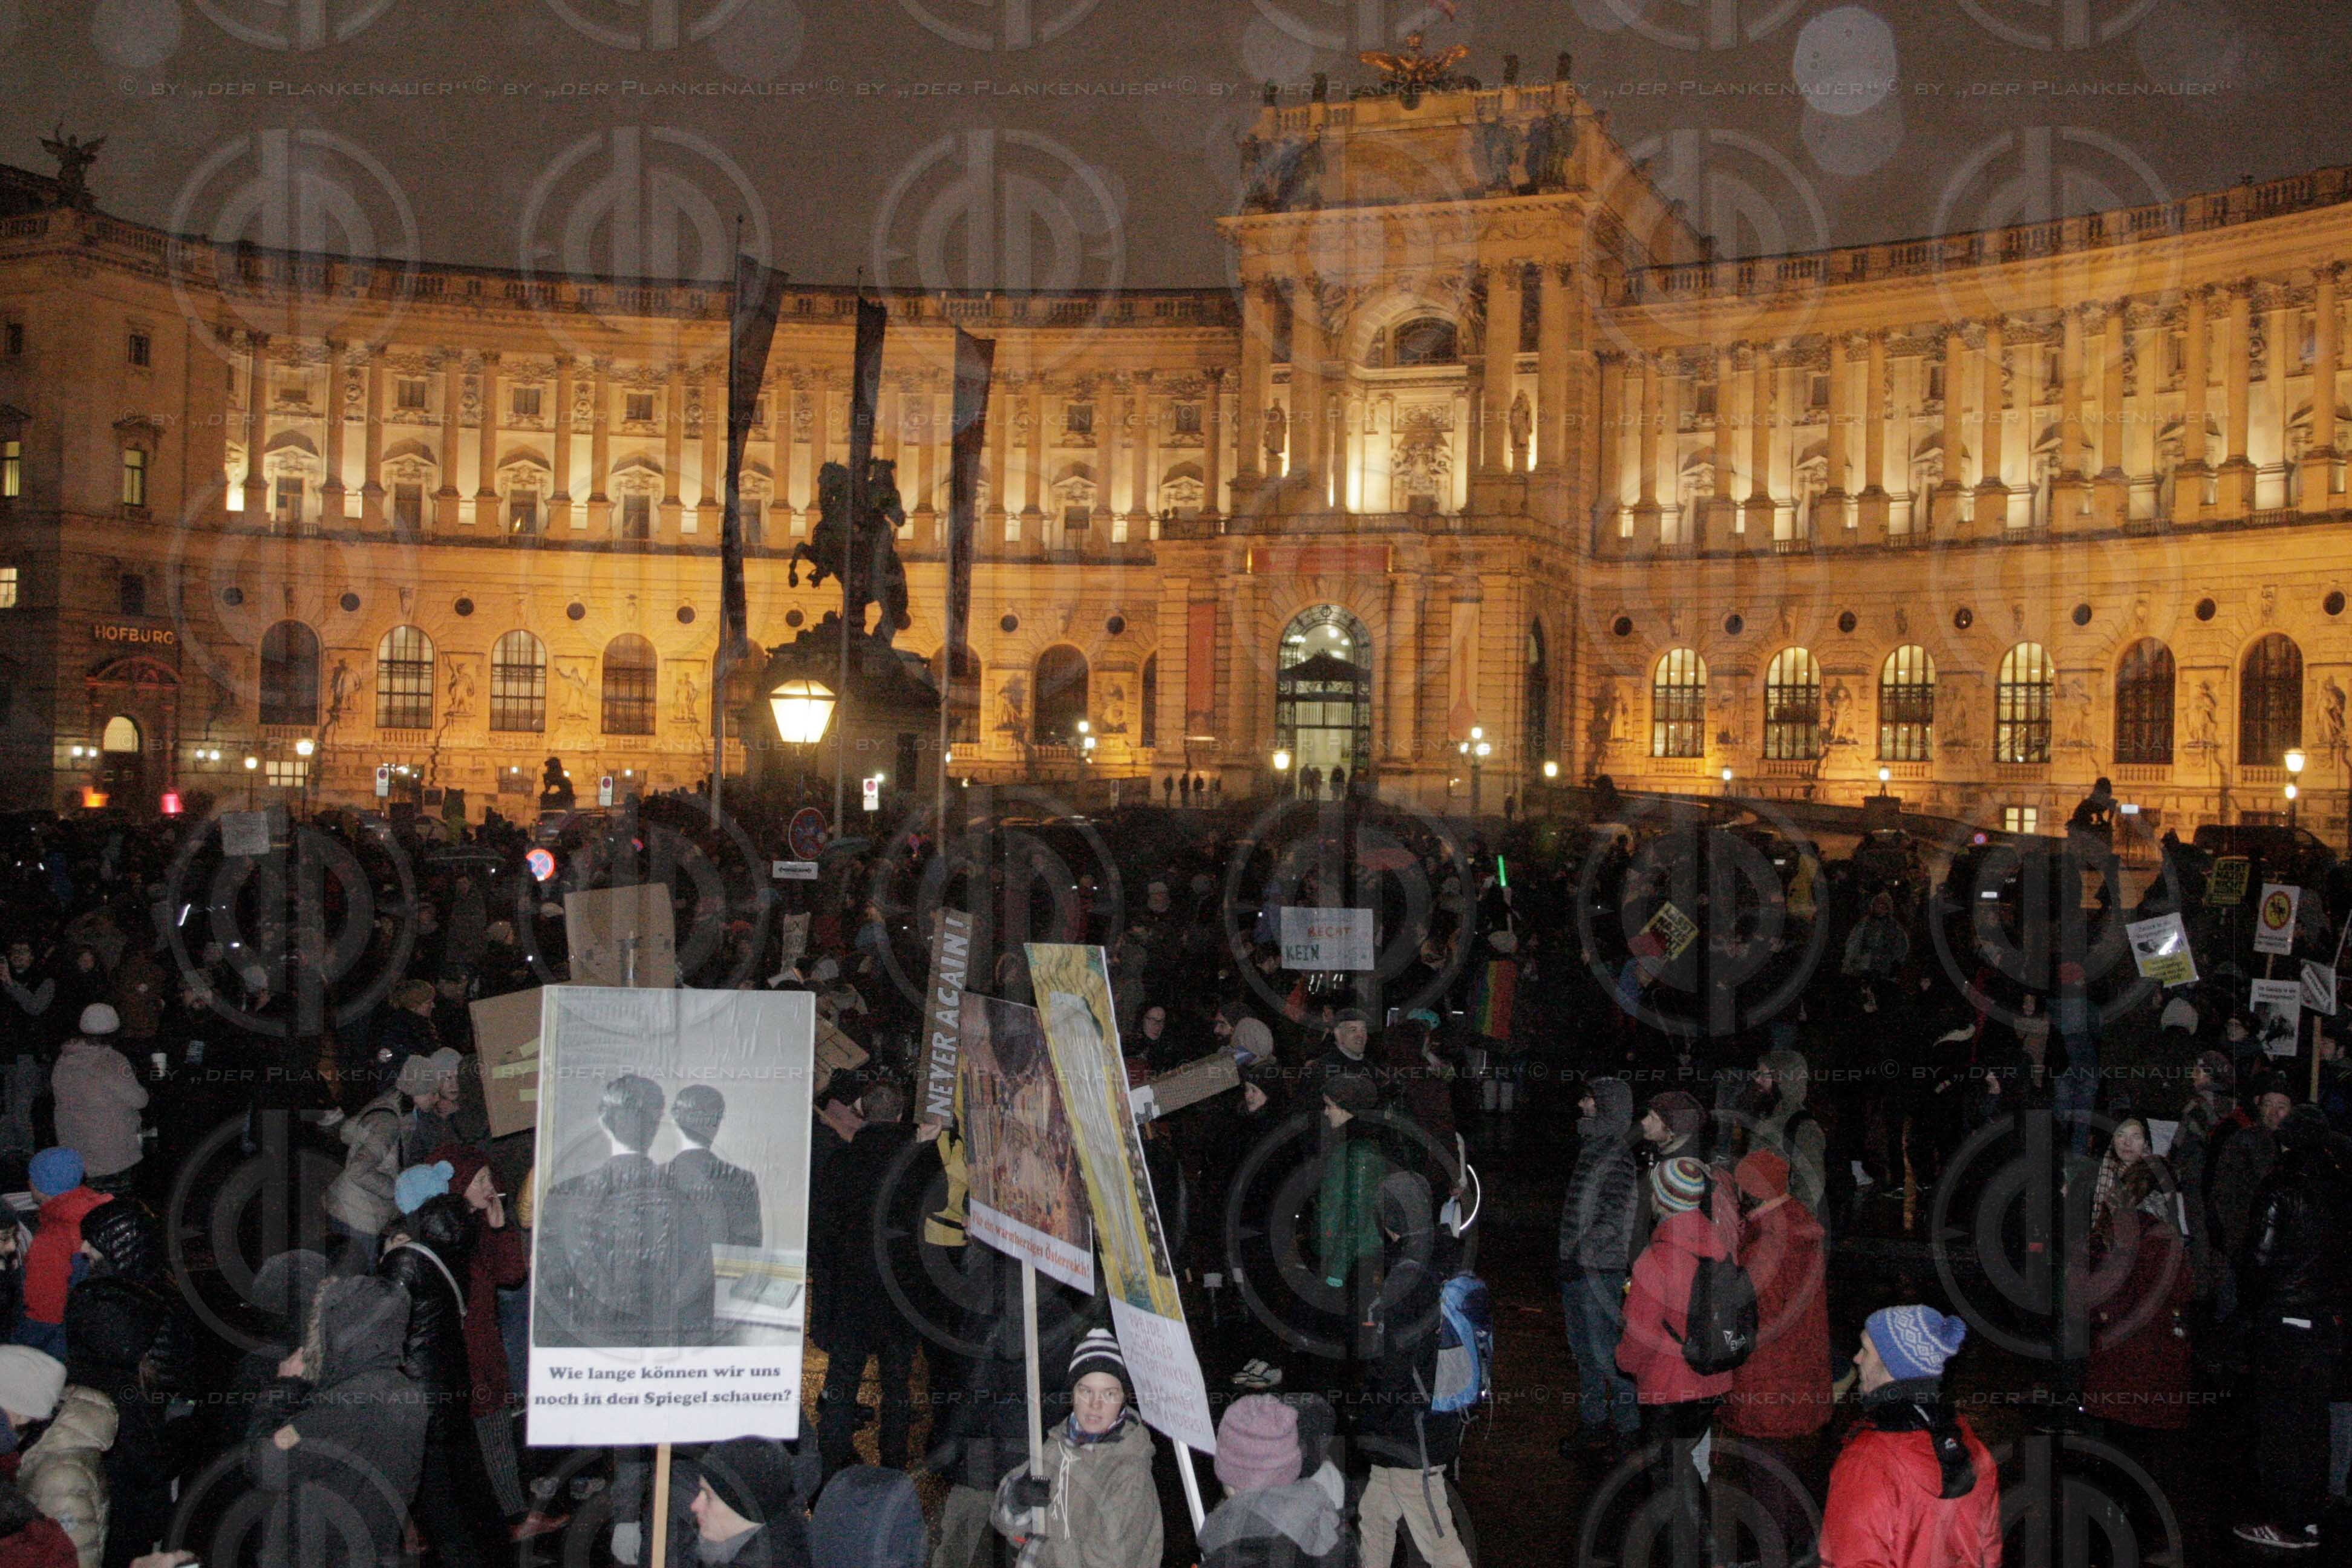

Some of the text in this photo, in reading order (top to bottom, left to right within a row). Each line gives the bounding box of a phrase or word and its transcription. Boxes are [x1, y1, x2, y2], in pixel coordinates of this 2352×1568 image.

[94, 624, 175, 645] HOFBURG
[1285, 944, 1319, 961] KEIN
[927, 1031, 958, 1117] NEVER
[549, 1365, 781, 1383] Wie lange können wir uns
[534, 1393, 581, 1405] noch
[583, 1393, 602, 1405] in
[607, 1392, 639, 1405] den
[644, 1391, 708, 1407] Spiegel
[712, 1389, 792, 1402] schauen?
